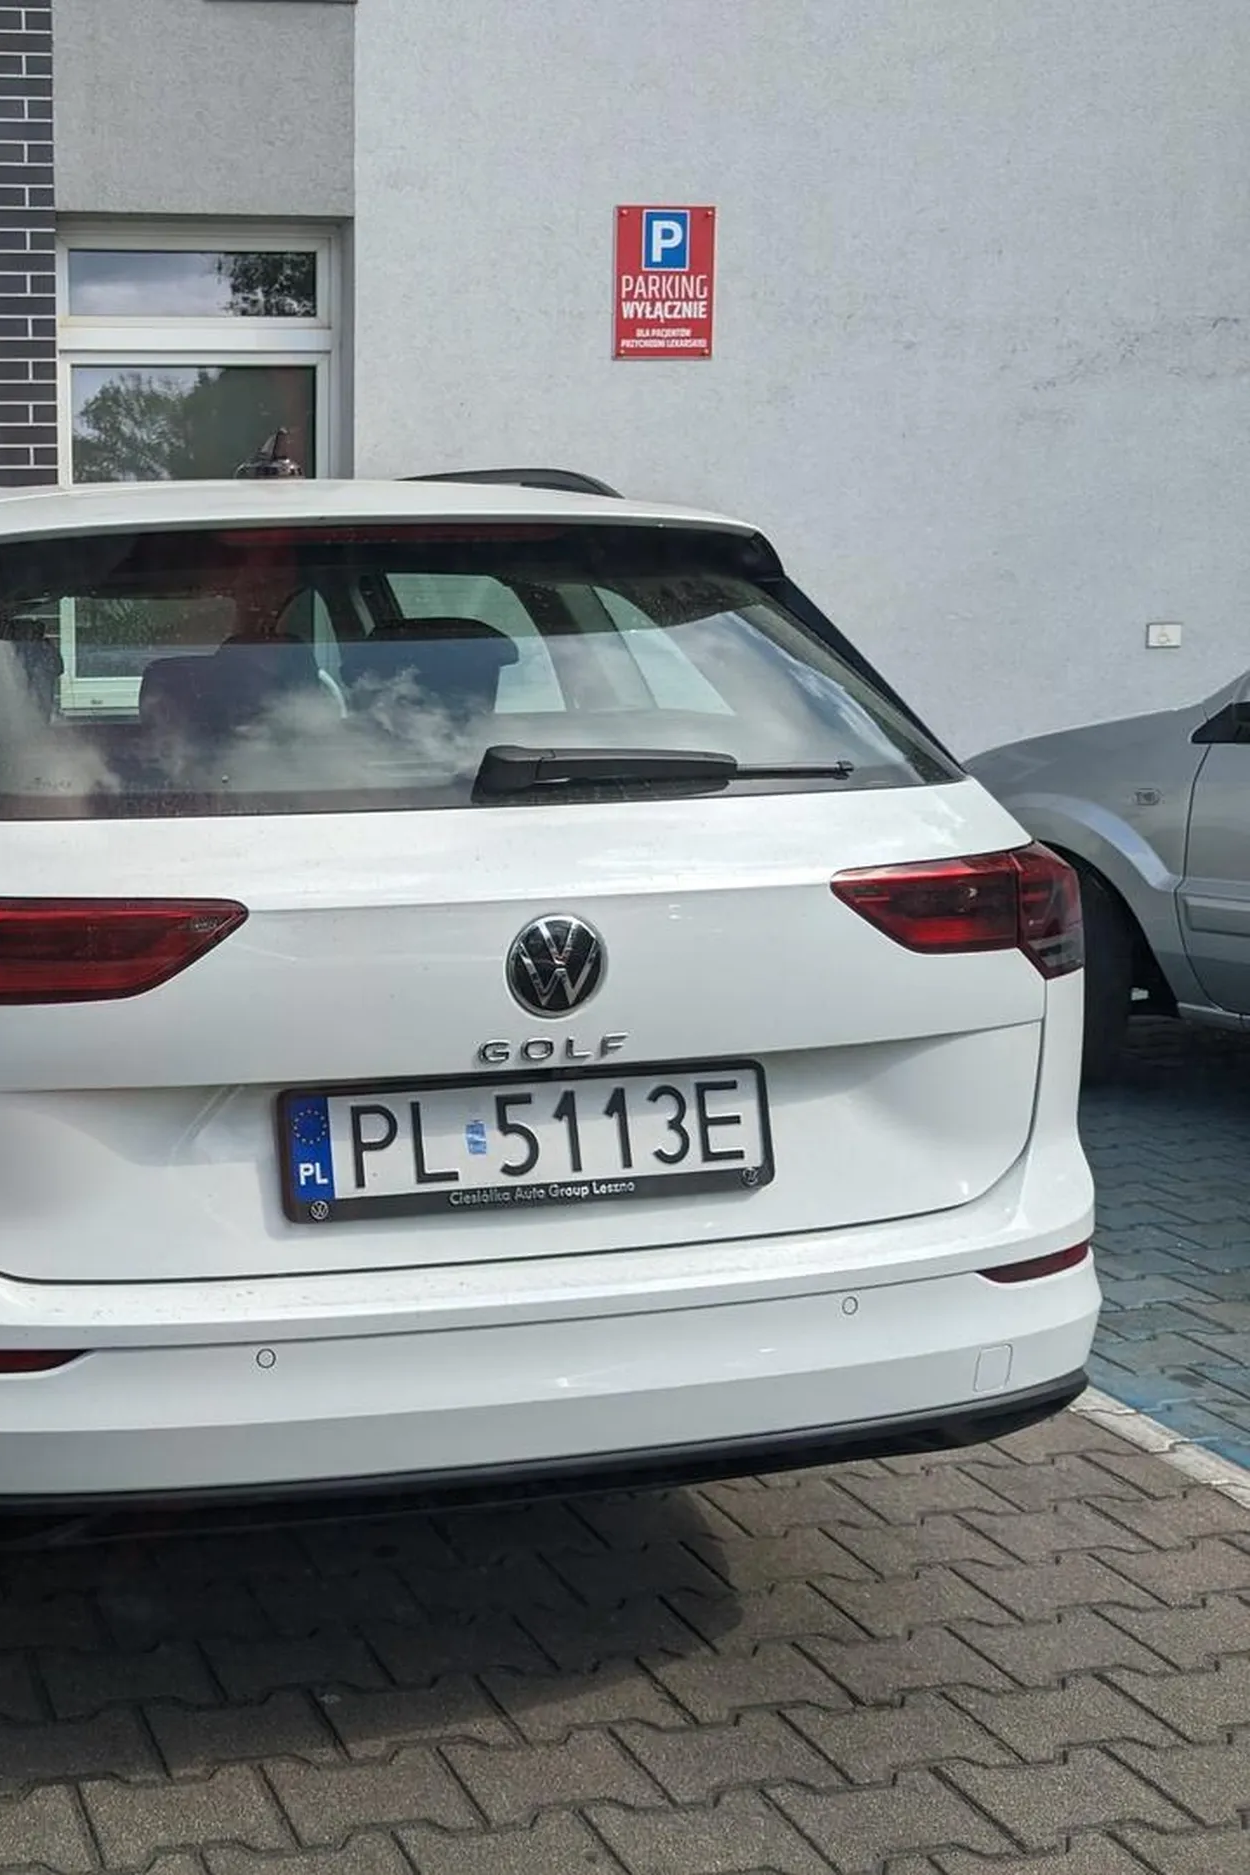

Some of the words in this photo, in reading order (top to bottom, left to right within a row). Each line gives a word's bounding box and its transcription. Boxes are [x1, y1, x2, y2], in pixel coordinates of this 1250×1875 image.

[651, 220, 683, 262] P
[621, 275, 708, 299] PARKING
[622, 300, 707, 323] WYŁĄCZNIE
[479, 1032, 628, 1062] GOLF
[350, 1101, 459, 1188] PL
[494, 1080, 745, 1177] 5113E
[299, 1162, 328, 1186] PL
[514, 1187, 545, 1201] Auto
[549, 1184, 589, 1198] Group
[593, 1181, 635, 1195] Leszno
